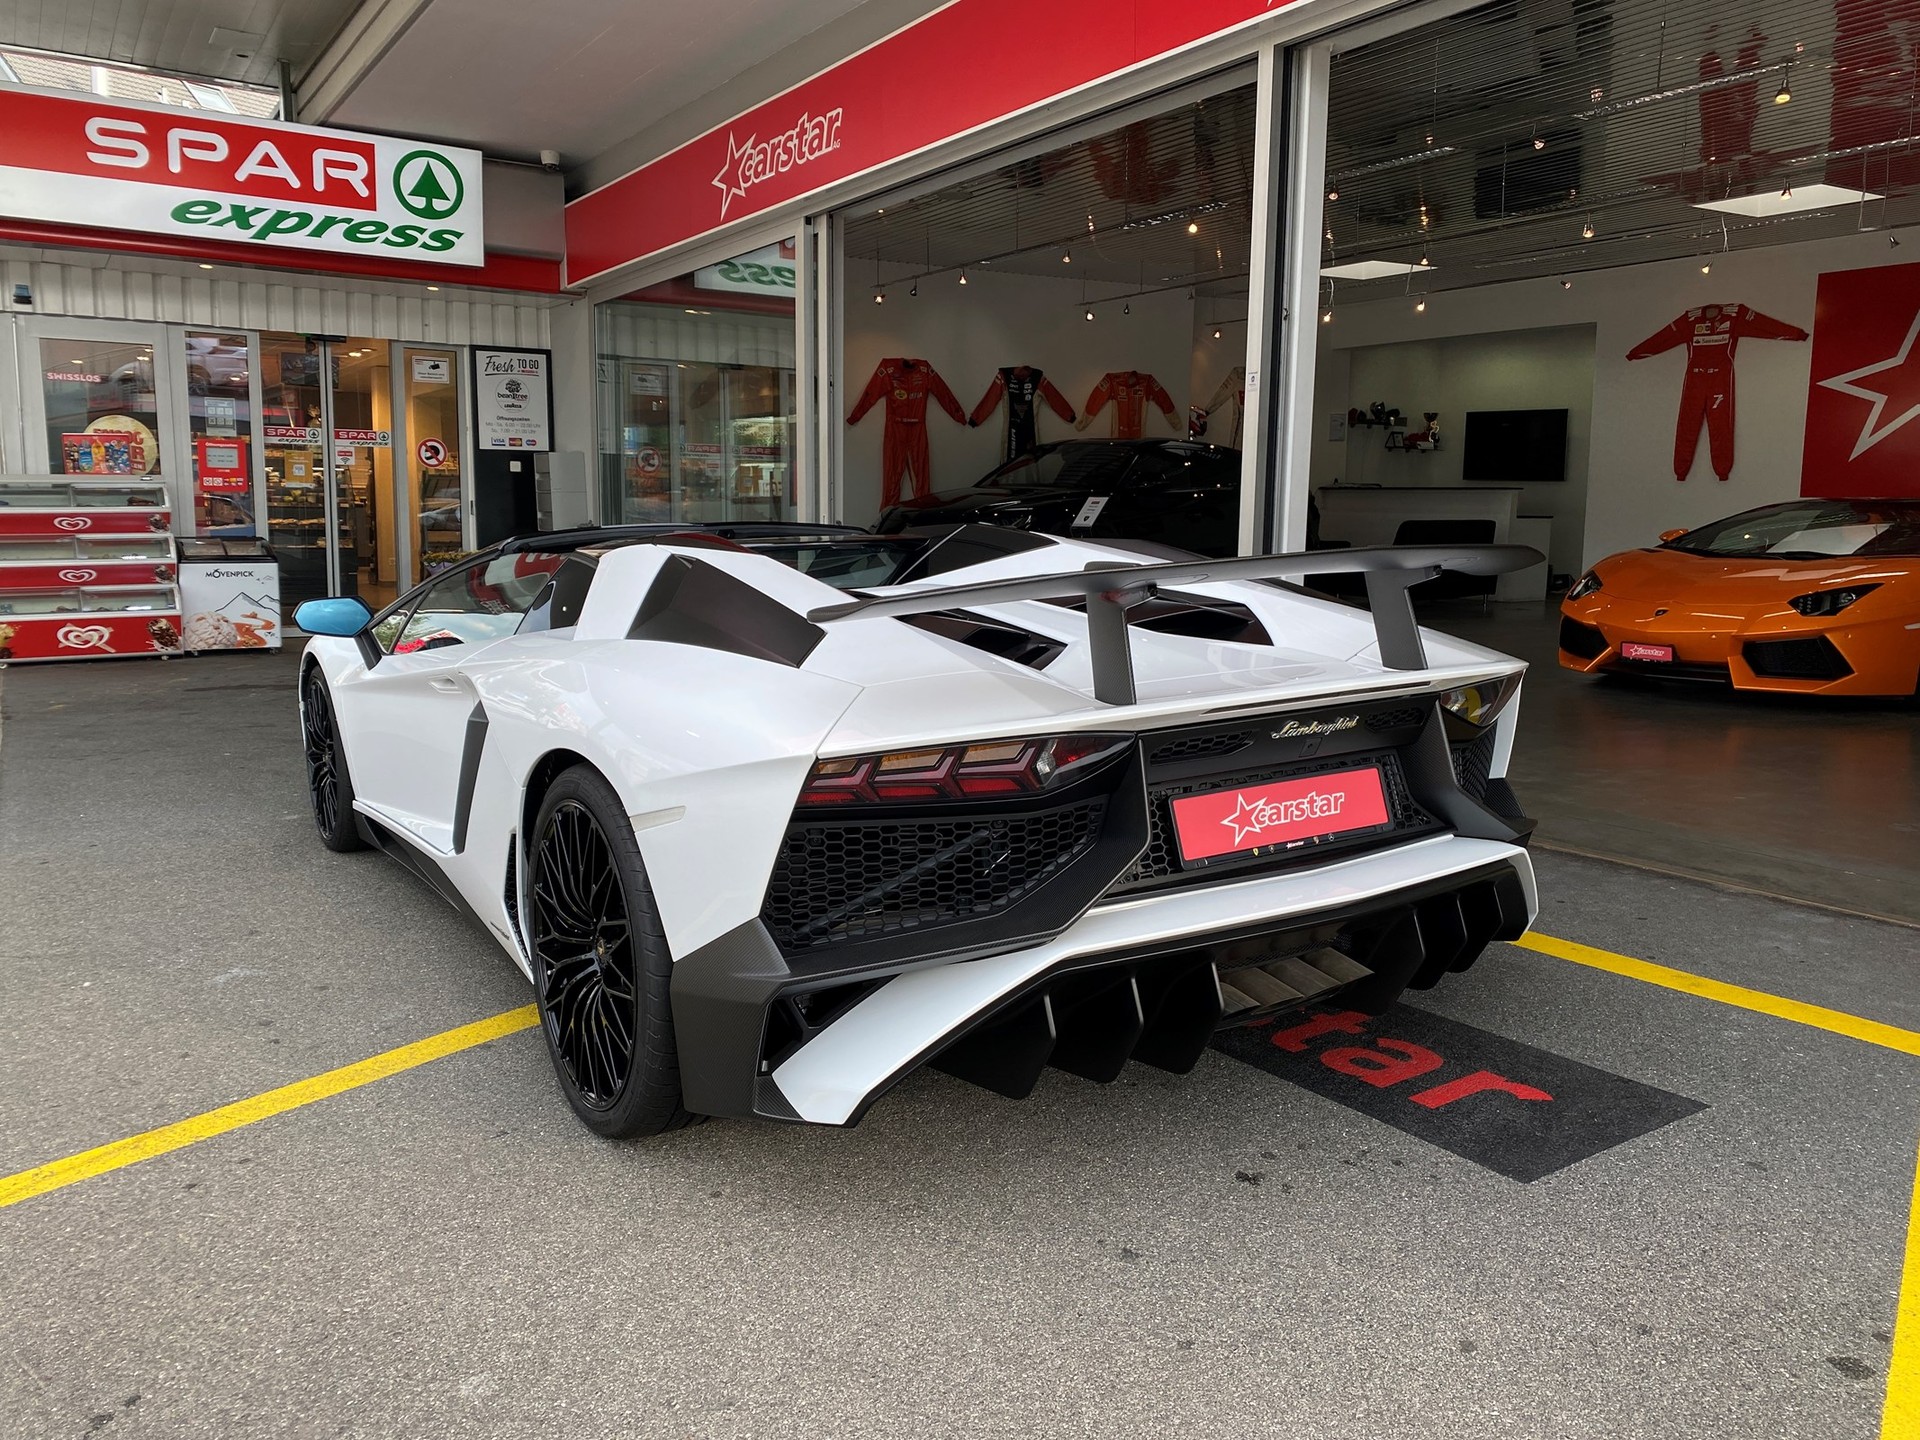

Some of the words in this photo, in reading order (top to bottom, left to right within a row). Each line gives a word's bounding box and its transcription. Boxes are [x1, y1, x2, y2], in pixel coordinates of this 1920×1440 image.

[84, 116, 371, 199] SPAR
[738, 107, 843, 188] carstar
[169, 198, 465, 252] express
[484, 355, 516, 373] Fresh
[517, 358, 527, 369] TO
[528, 359, 539, 370] GO
[46, 372, 102, 383] SWISSLOS
[1712, 394, 1724, 409] 7
[266, 428, 306, 437] SPAR
[338, 431, 376, 439] SPAR
[1271, 715, 1360, 739] Lamborghini
[1255, 791, 1345, 828] carstar
[1248, 1009, 1554, 1109] tar
